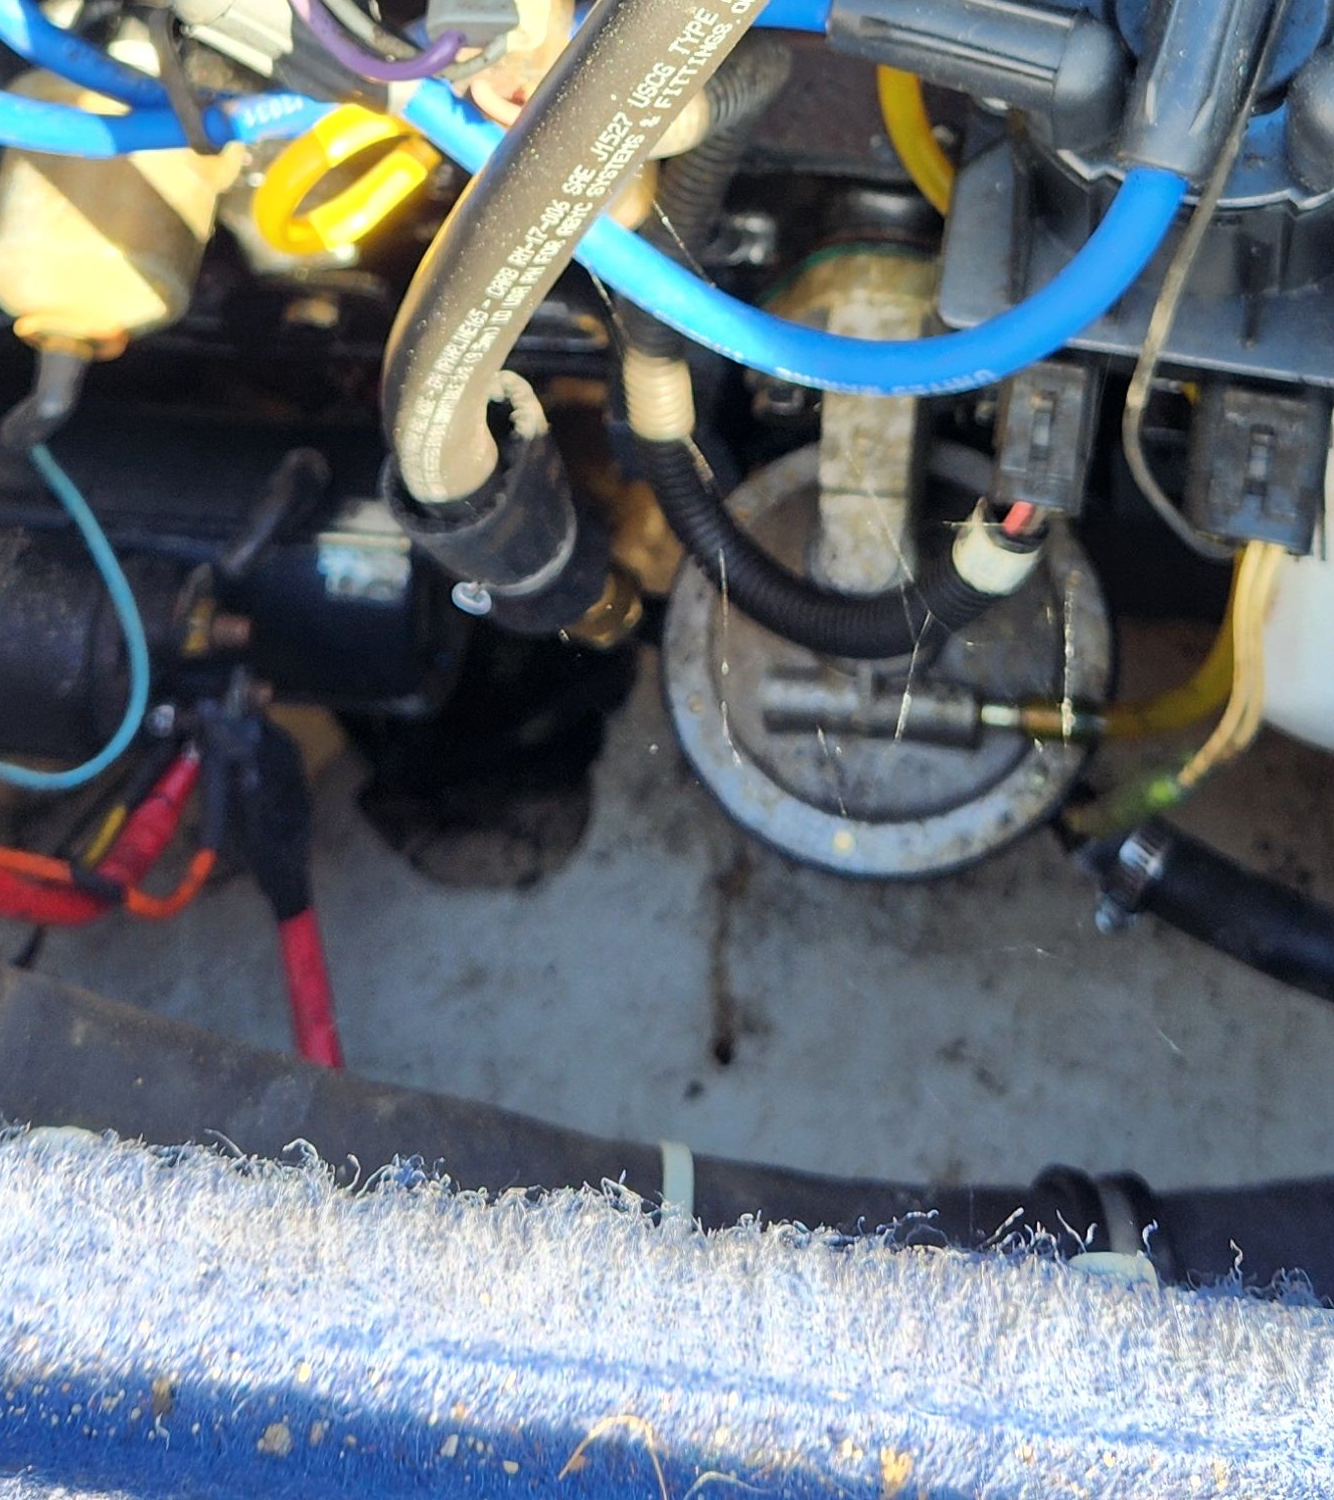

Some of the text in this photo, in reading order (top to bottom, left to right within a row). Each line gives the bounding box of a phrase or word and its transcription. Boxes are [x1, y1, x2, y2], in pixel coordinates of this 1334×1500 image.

[485, 266, 520, 299] CARB
[561, 164, 597, 196] SAE
[589, 111, 635, 163] J1527
[627, 60, 676, 110] USCG
[669, 6, 720, 57] TYPE
[556, 202, 594, 236] ABYC
[586, 132, 647, 197] SYSTEMS
[640, 114, 662, 130] &
